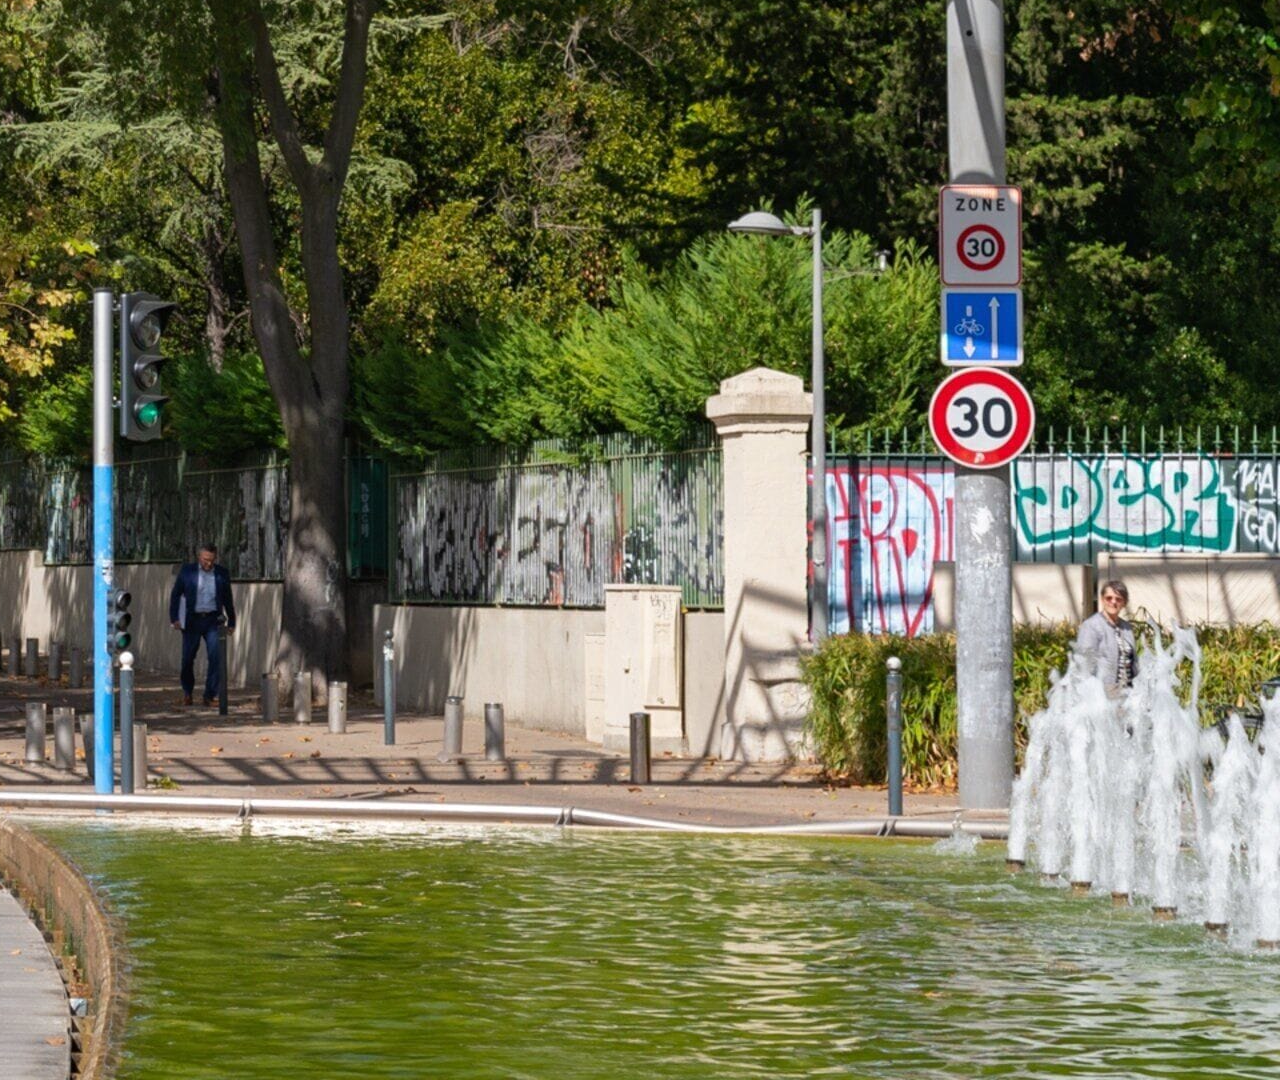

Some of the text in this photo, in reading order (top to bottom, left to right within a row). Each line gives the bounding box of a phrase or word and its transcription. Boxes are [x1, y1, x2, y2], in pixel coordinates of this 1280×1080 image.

[956, 198, 1006, 212] ZONE
[967, 238, 996, 258] 30
[952, 397, 1013, 439] 30
